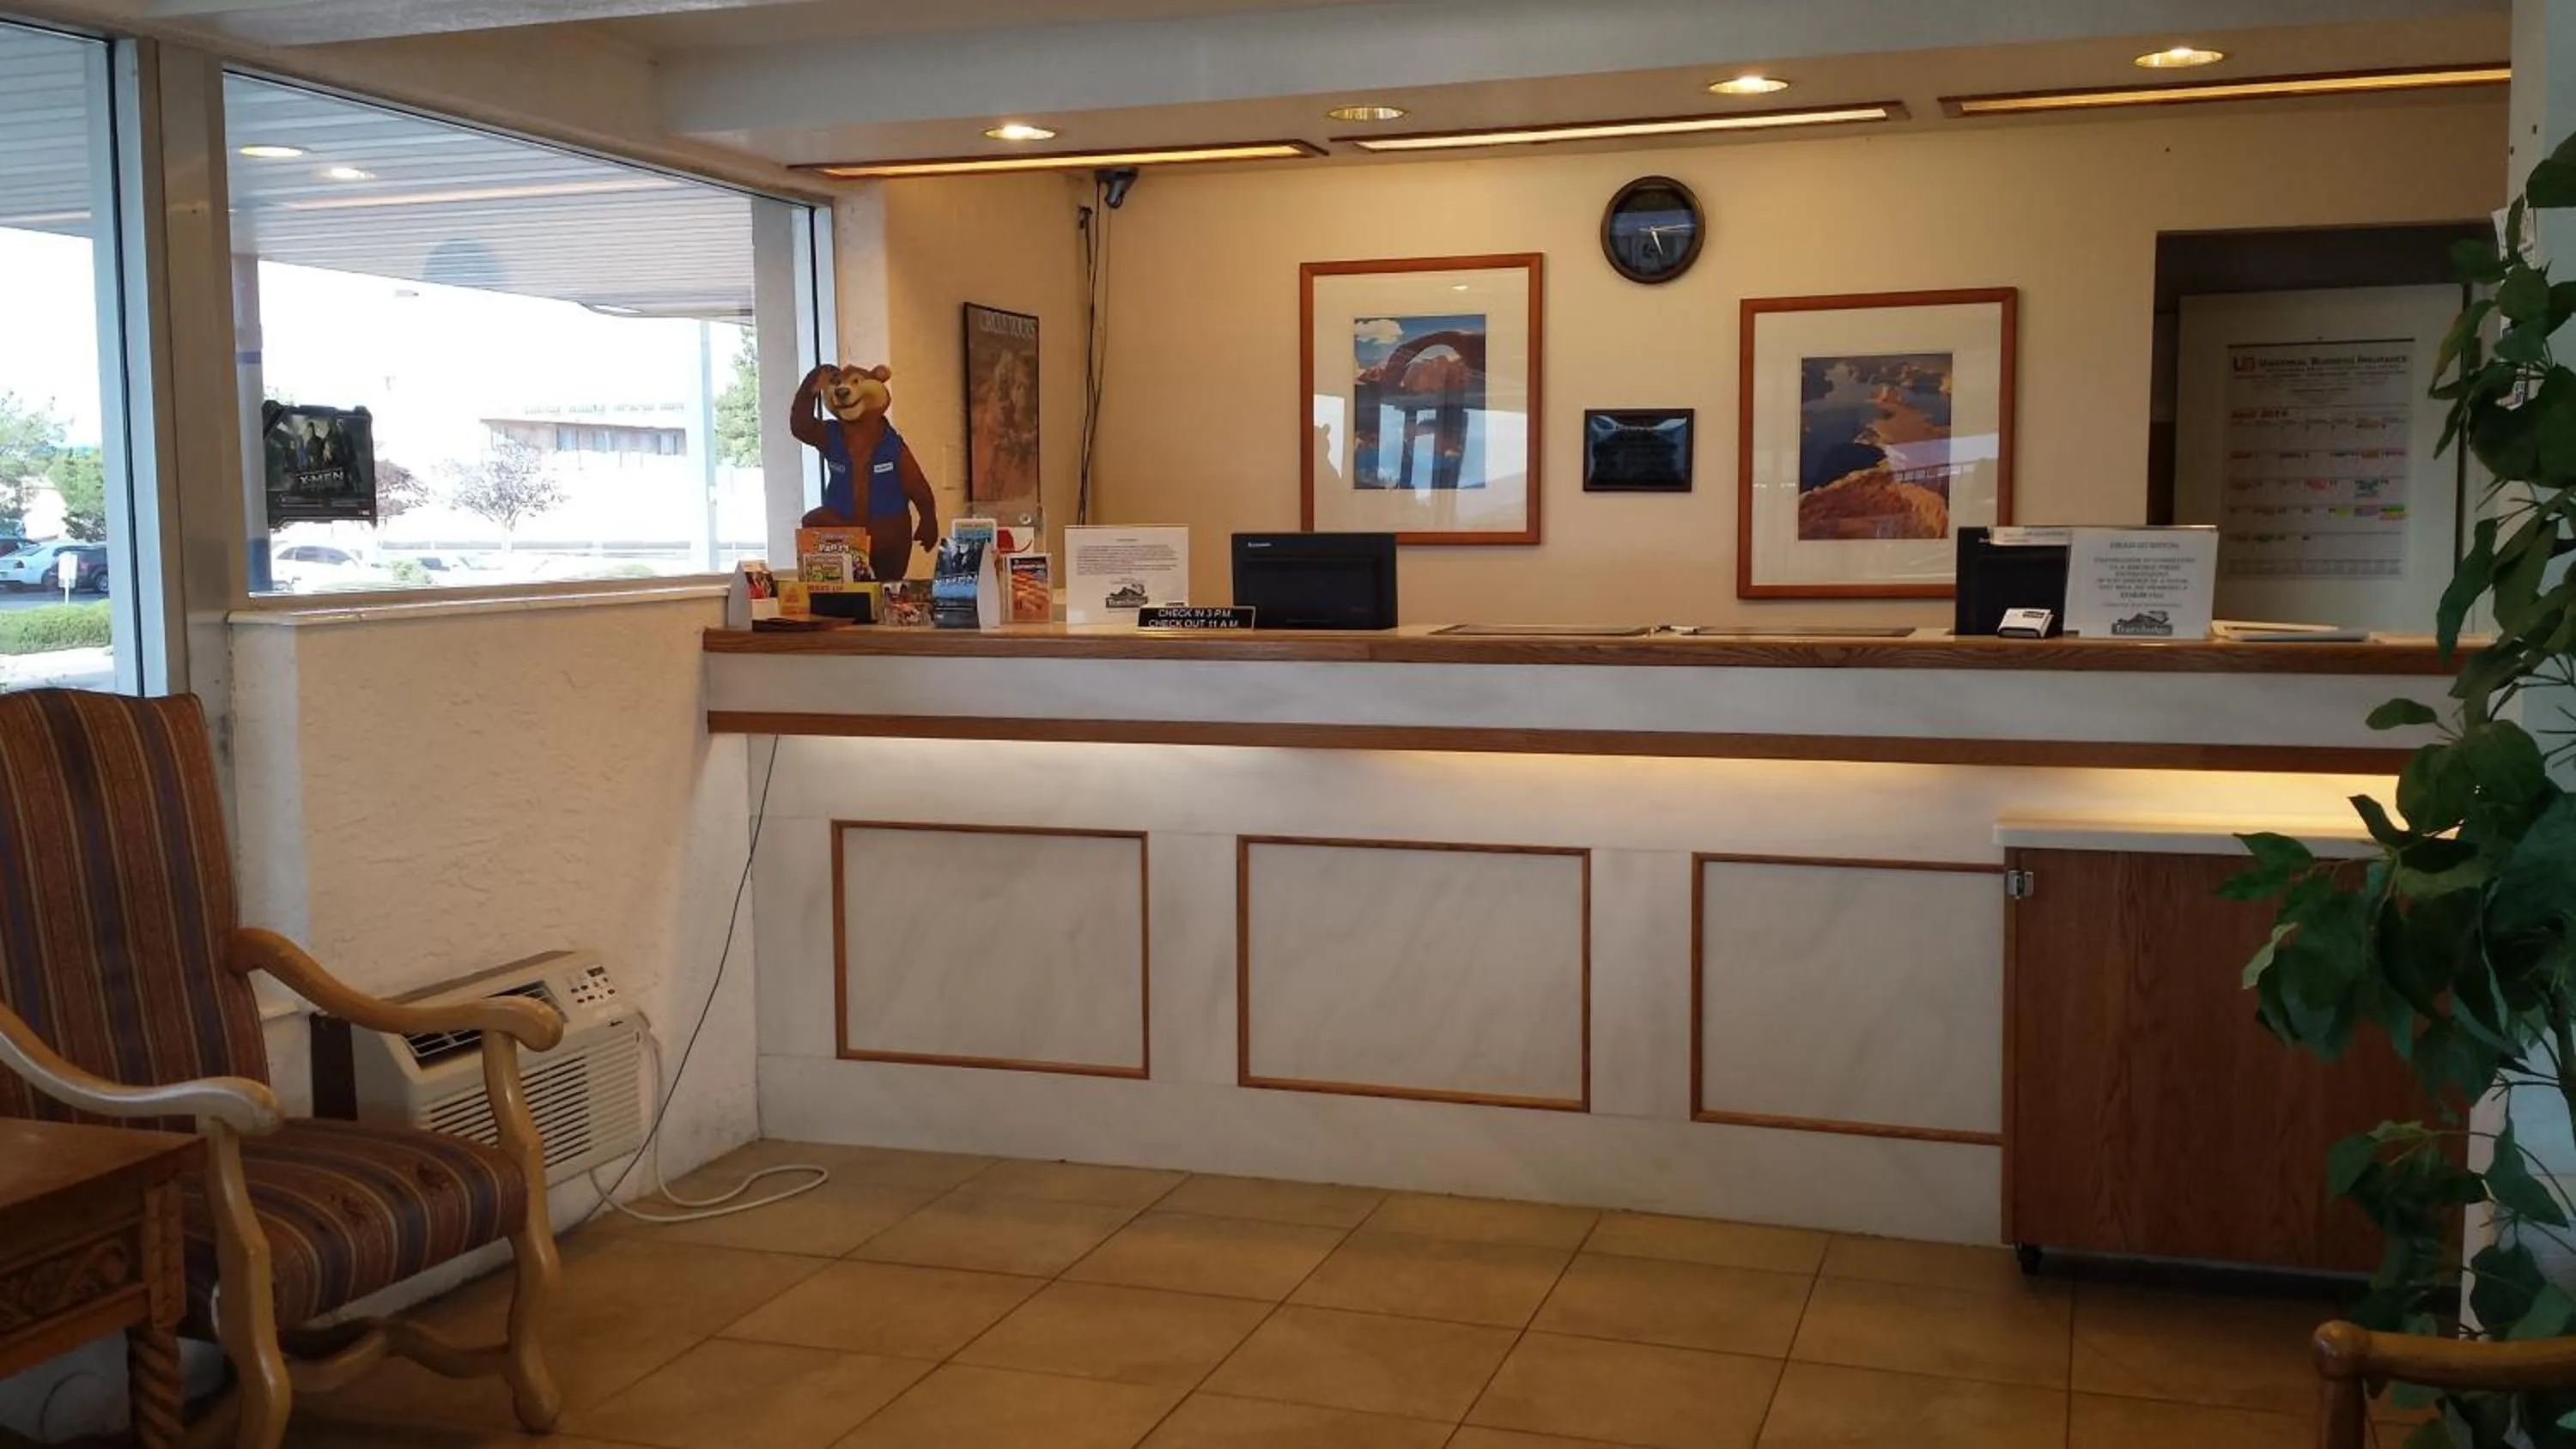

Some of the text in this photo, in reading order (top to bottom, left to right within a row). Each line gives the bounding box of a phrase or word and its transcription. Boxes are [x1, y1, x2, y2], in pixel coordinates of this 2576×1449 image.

[1157, 609, 1192, 618] CHECK
[1194, 609, 1205, 618] IN
[1148, 619, 1182, 627] CHECK
[1184, 619, 1206, 627] OUT
